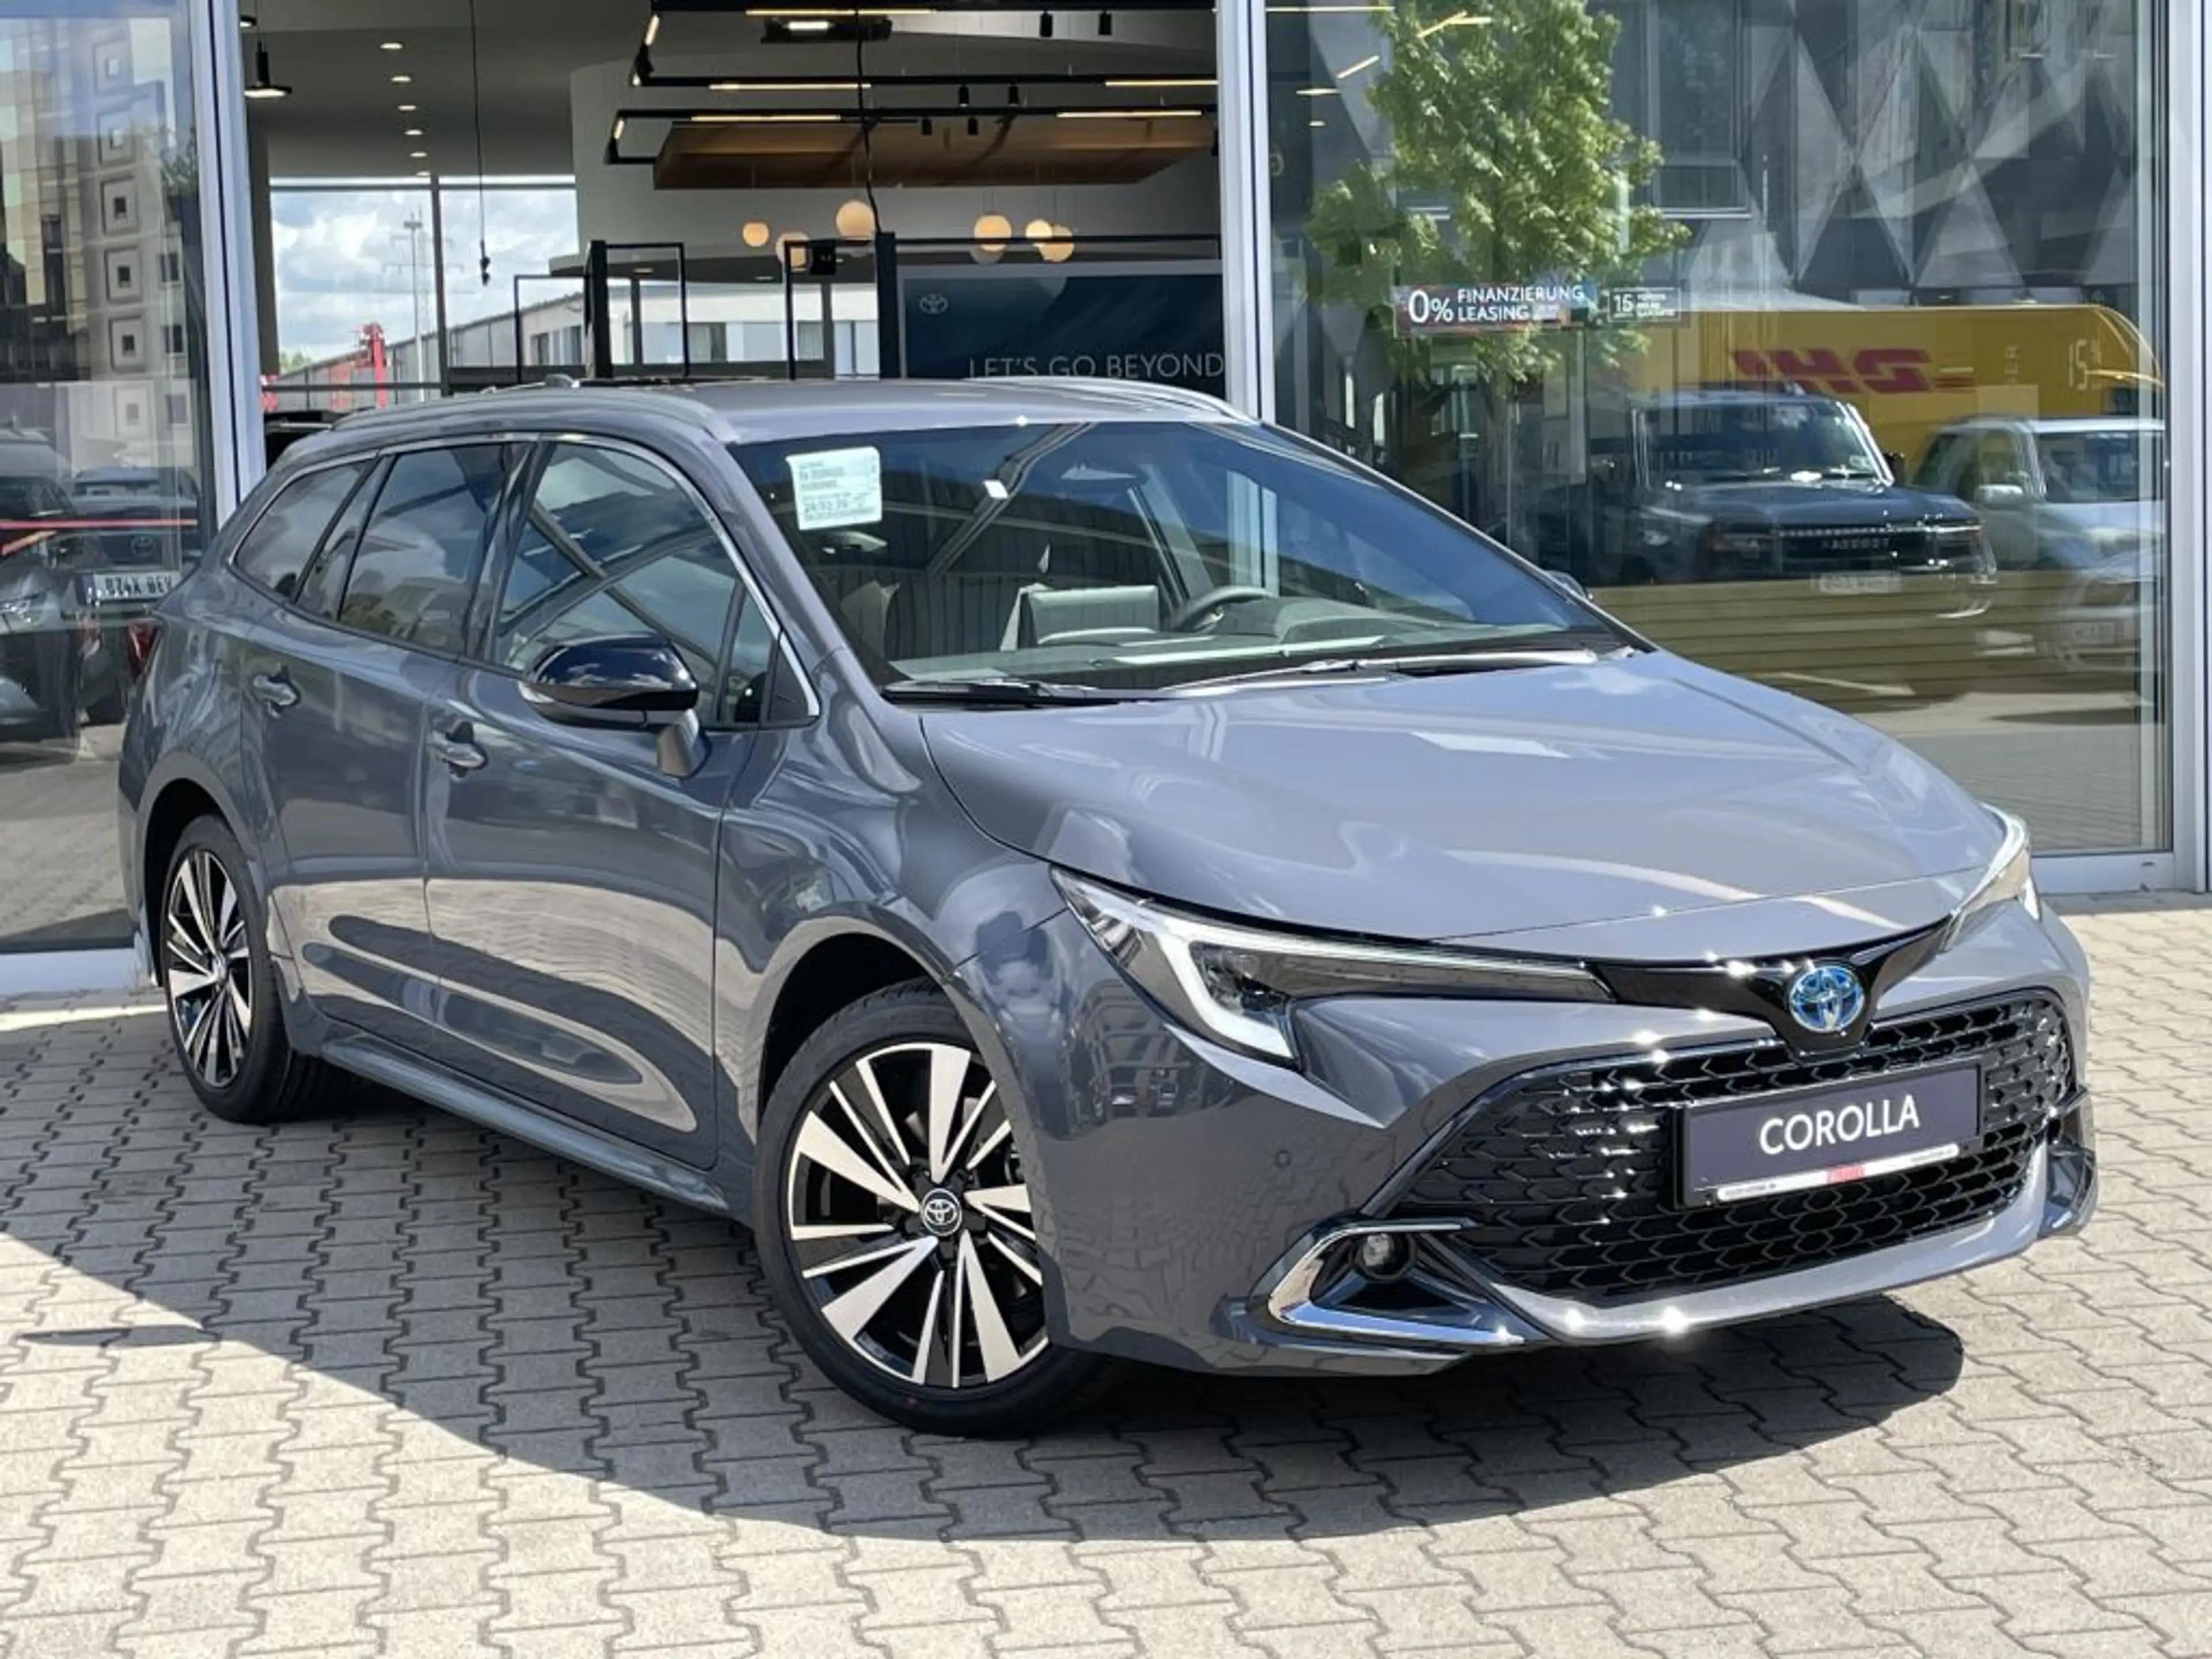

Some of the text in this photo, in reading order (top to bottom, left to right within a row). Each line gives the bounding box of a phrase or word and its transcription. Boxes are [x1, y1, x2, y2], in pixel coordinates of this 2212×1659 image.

[1408, 289, 1453, 323] 0%
[1457, 285, 1585, 303] FINANZIERUNG
[1457, 305, 1530, 322] LEASING
[969, 353, 1224, 378] LET'S GO BEYOND
[1759, 1094, 1921, 1155] COROLLA
